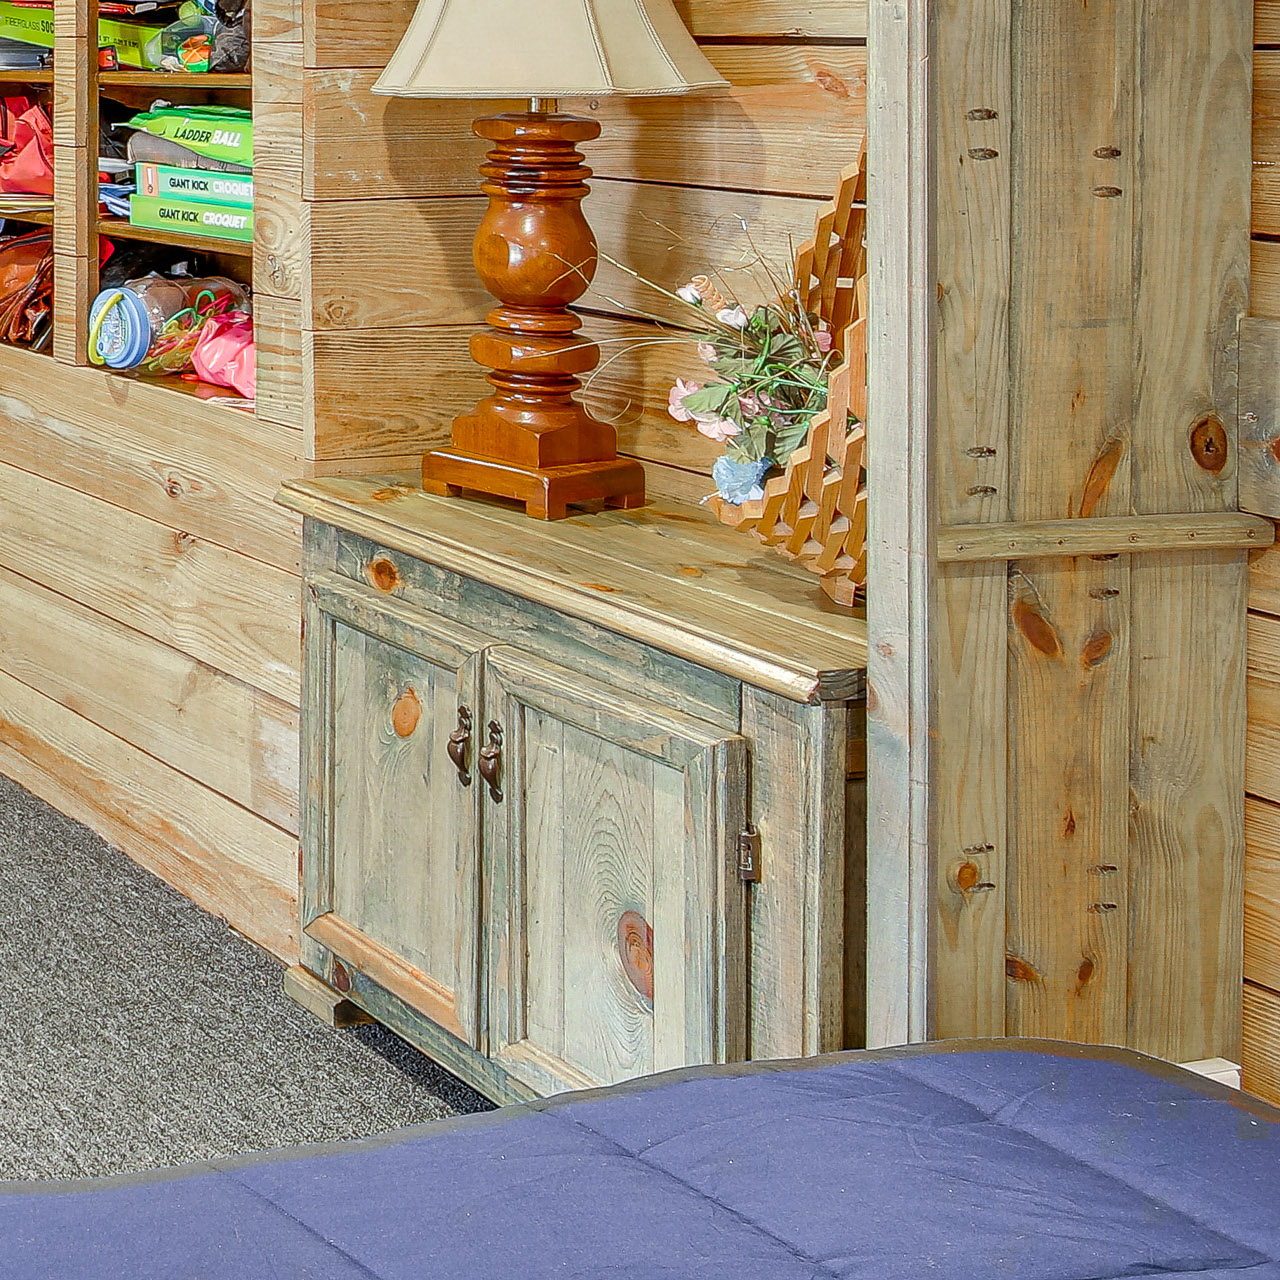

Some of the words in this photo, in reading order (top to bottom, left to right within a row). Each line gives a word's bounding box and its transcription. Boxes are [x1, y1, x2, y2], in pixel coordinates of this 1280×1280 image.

[5, 16, 40, 31] FIBERGLASS
[174, 127, 212, 143] LADDER
[211, 130, 242, 147] BALL
[169, 178, 190, 190] GIANT
[191, 181, 209, 191] KICK
[159, 208, 180, 220] GIANT
[181, 211, 200, 222] KICK
[203, 212, 247, 229] CROQUET
